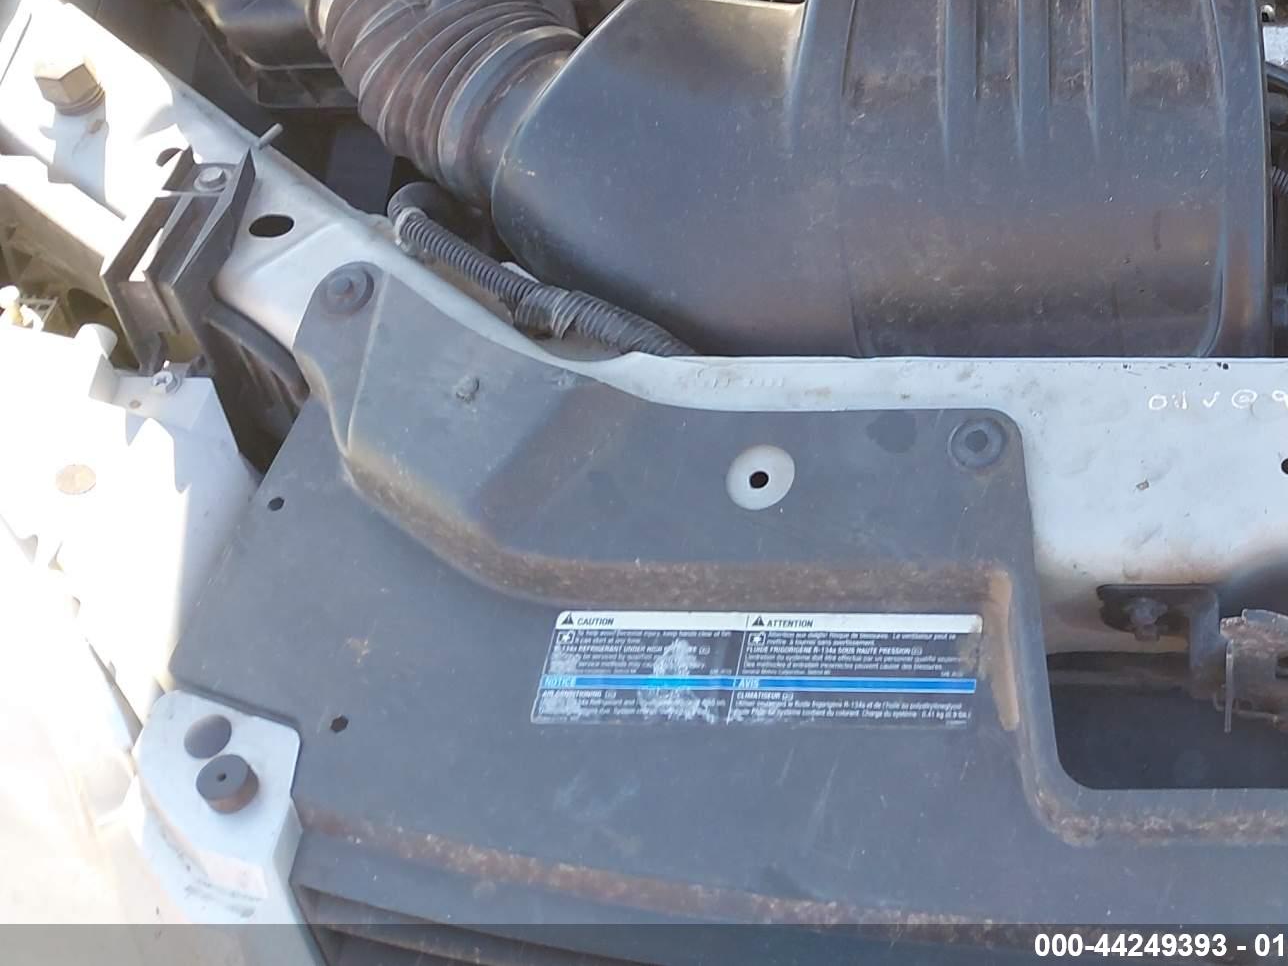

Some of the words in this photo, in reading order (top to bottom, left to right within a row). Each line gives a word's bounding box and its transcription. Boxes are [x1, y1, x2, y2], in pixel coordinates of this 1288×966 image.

[577, 618, 615, 626] CAUTION
[766, 619, 815, 628] ATTENTION
[738, 678, 759, 688] AVIS
